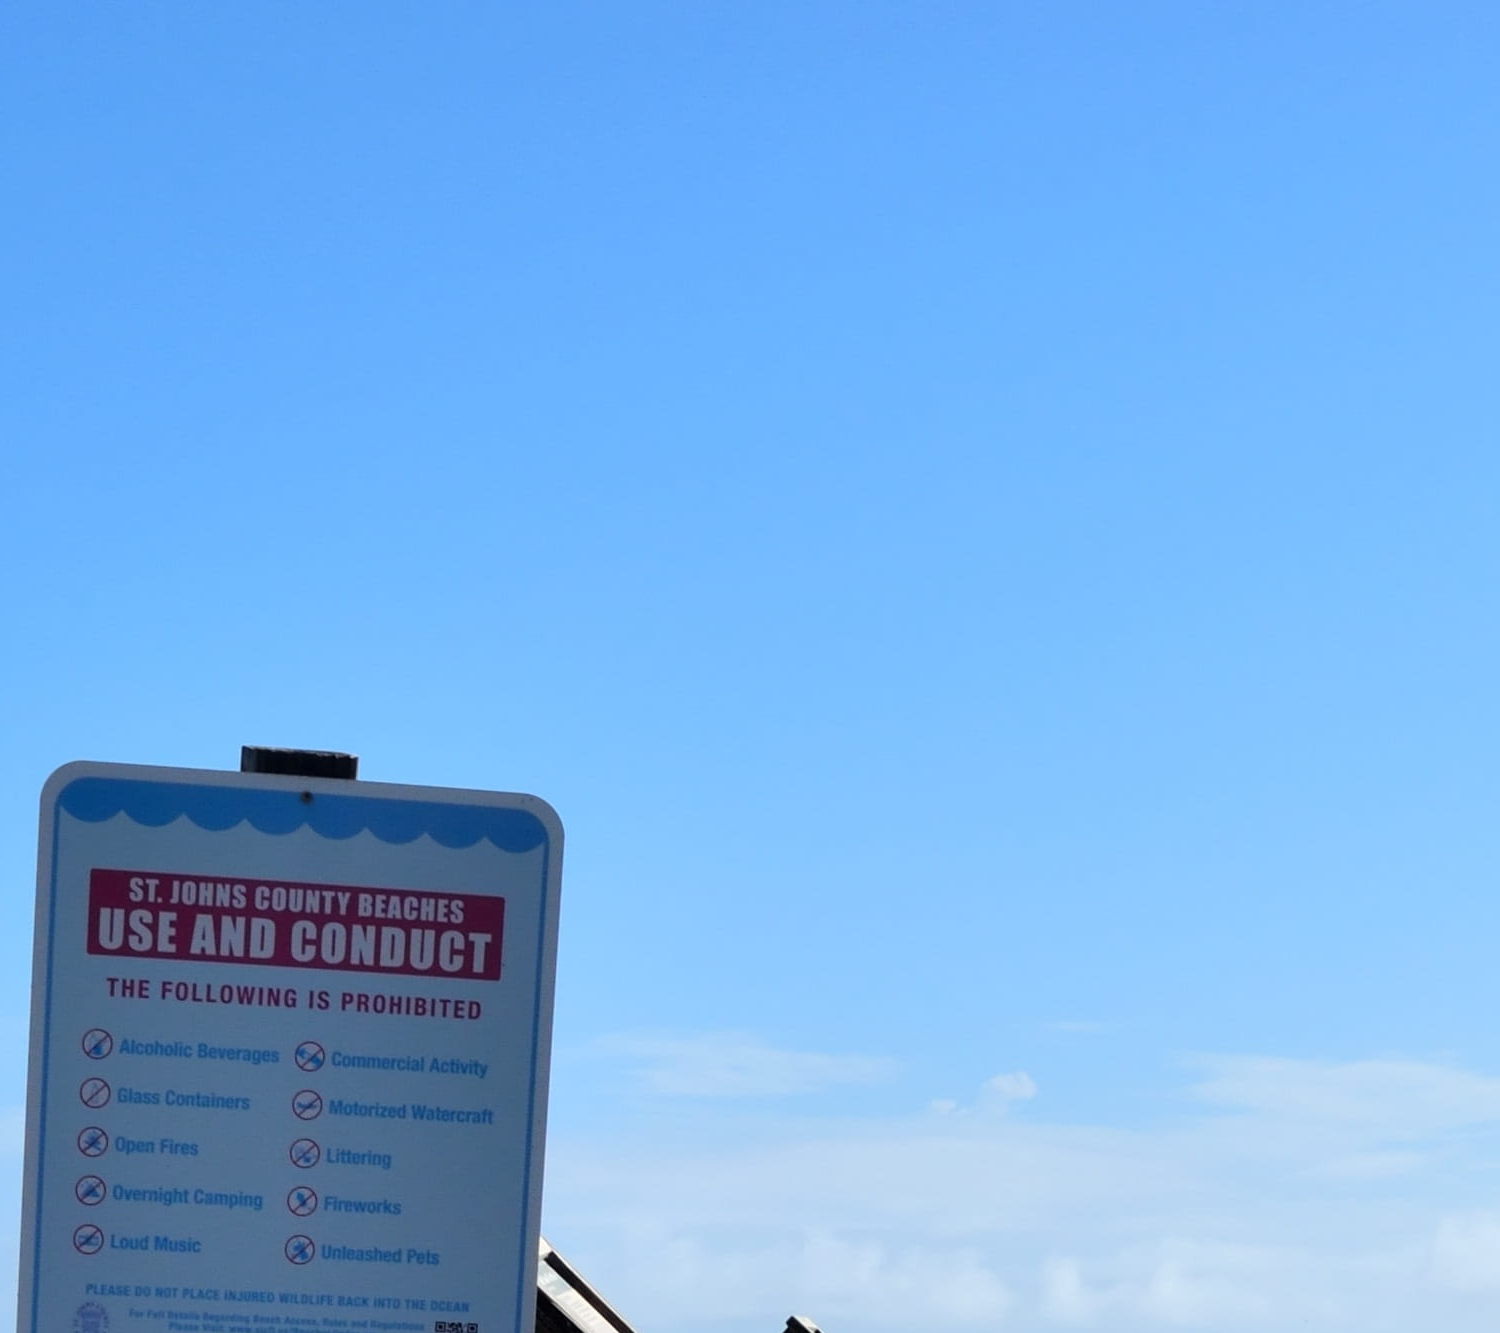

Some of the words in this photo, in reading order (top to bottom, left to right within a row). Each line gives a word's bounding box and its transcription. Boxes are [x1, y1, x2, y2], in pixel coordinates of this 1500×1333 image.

[129, 877, 162, 903] ST.
[170, 879, 246, 909] JOHNS
[254, 885, 350, 916] COUNTY
[357, 892, 464, 924] BEACHES
[98, 906, 177, 953] USE
[190, 912, 276, 959] AND
[290, 919, 491, 974] CONDUCT
[106, 977, 150, 999] THE
[161, 981, 297, 1008] FOLLOWING
[308, 990, 330, 1010] IS
[341, 992, 481, 1020] PROHIBITED
[118, 1038, 193, 1058] Alcoholic
[196, 1042, 279, 1065] Beverages
[331, 1051, 425, 1072] Commercial
[428, 1057, 488, 1079] Activity
[117, 1087, 161, 1105] Glass
[164, 1090, 250, 1110] Containers
[328, 1100, 407, 1119] Motorized
[411, 1104, 494, 1124] Watercraft
[114, 1136, 155, 1155] Open
[159, 1138, 198, 1155] Fires
[326, 1148, 392, 1169] Littering
[112, 1185, 189, 1206] Overnight
[193, 1189, 263, 1210] Camping
[323, 1196, 401, 1214] Fireworks
[110, 1234, 149, 1250] Loud
[153, 1235, 201, 1253] Music
[321, 1245, 402, 1263] Unleashed
[406, 1248, 440, 1265] Pets
[85, 1283, 131, 1296] PLEASE
[134, 1286, 151, 1297] DO
[154, 1286, 178, 1298] NOT
[182, 1288, 219, 1300] PLACE
[223, 1290, 275, 1303] INJURED
[278, 1292, 333, 1306] WILDLIFE
[337, 1295, 369, 1307] BACK
[373, 1297, 401, 1309] INTO
[404, 1298, 427, 1310] THE
[429, 1299, 470, 1313] OCEAN
